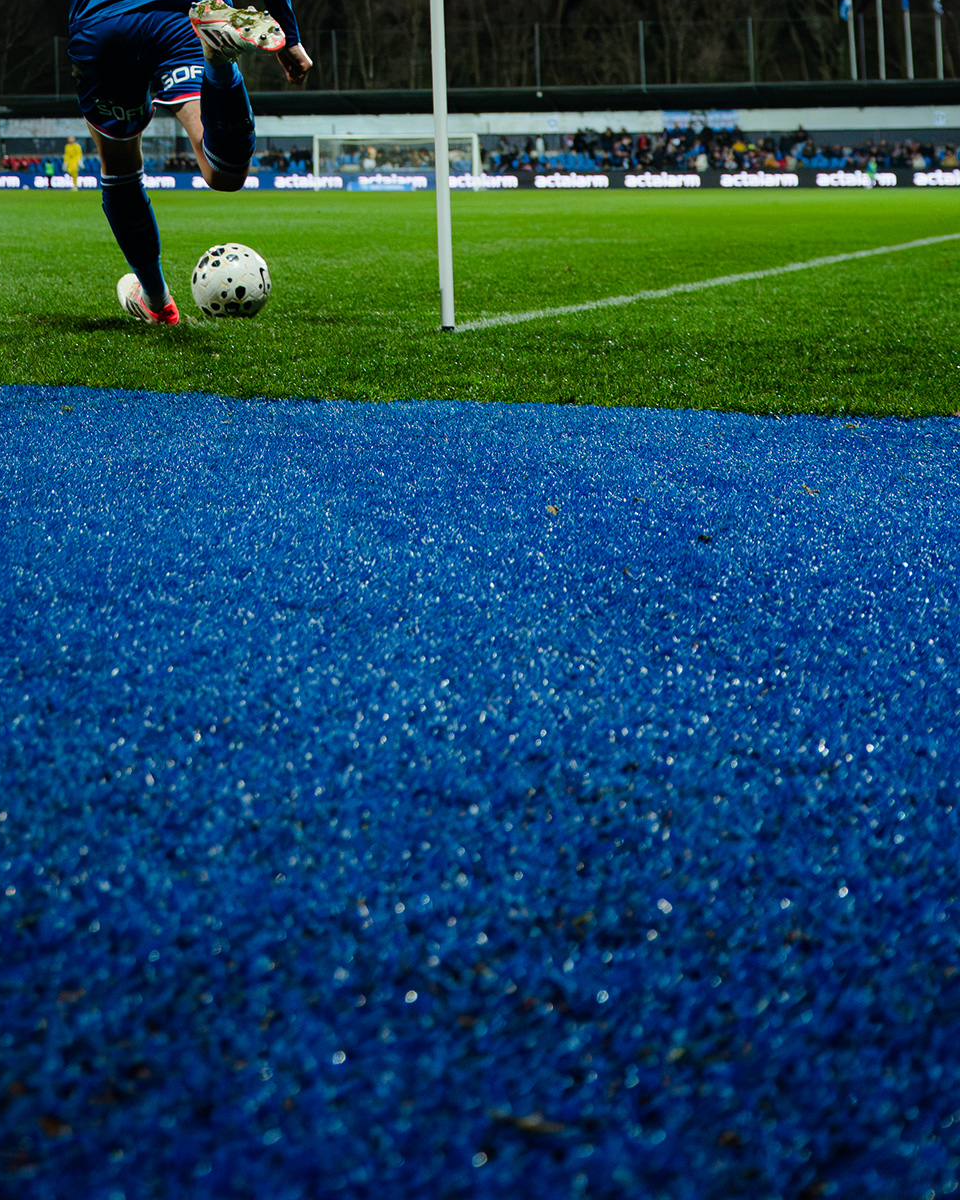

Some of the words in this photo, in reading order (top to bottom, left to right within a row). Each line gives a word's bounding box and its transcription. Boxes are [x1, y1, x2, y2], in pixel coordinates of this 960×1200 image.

[160, 65, 205, 92] SOF
[273, 173, 344, 189] actalrm
[448, 172, 519, 189] actlarm
[534, 172, 609, 188] actalarm
[624, 171, 701, 188] actalarm
[720, 170, 799, 187] actalarm
